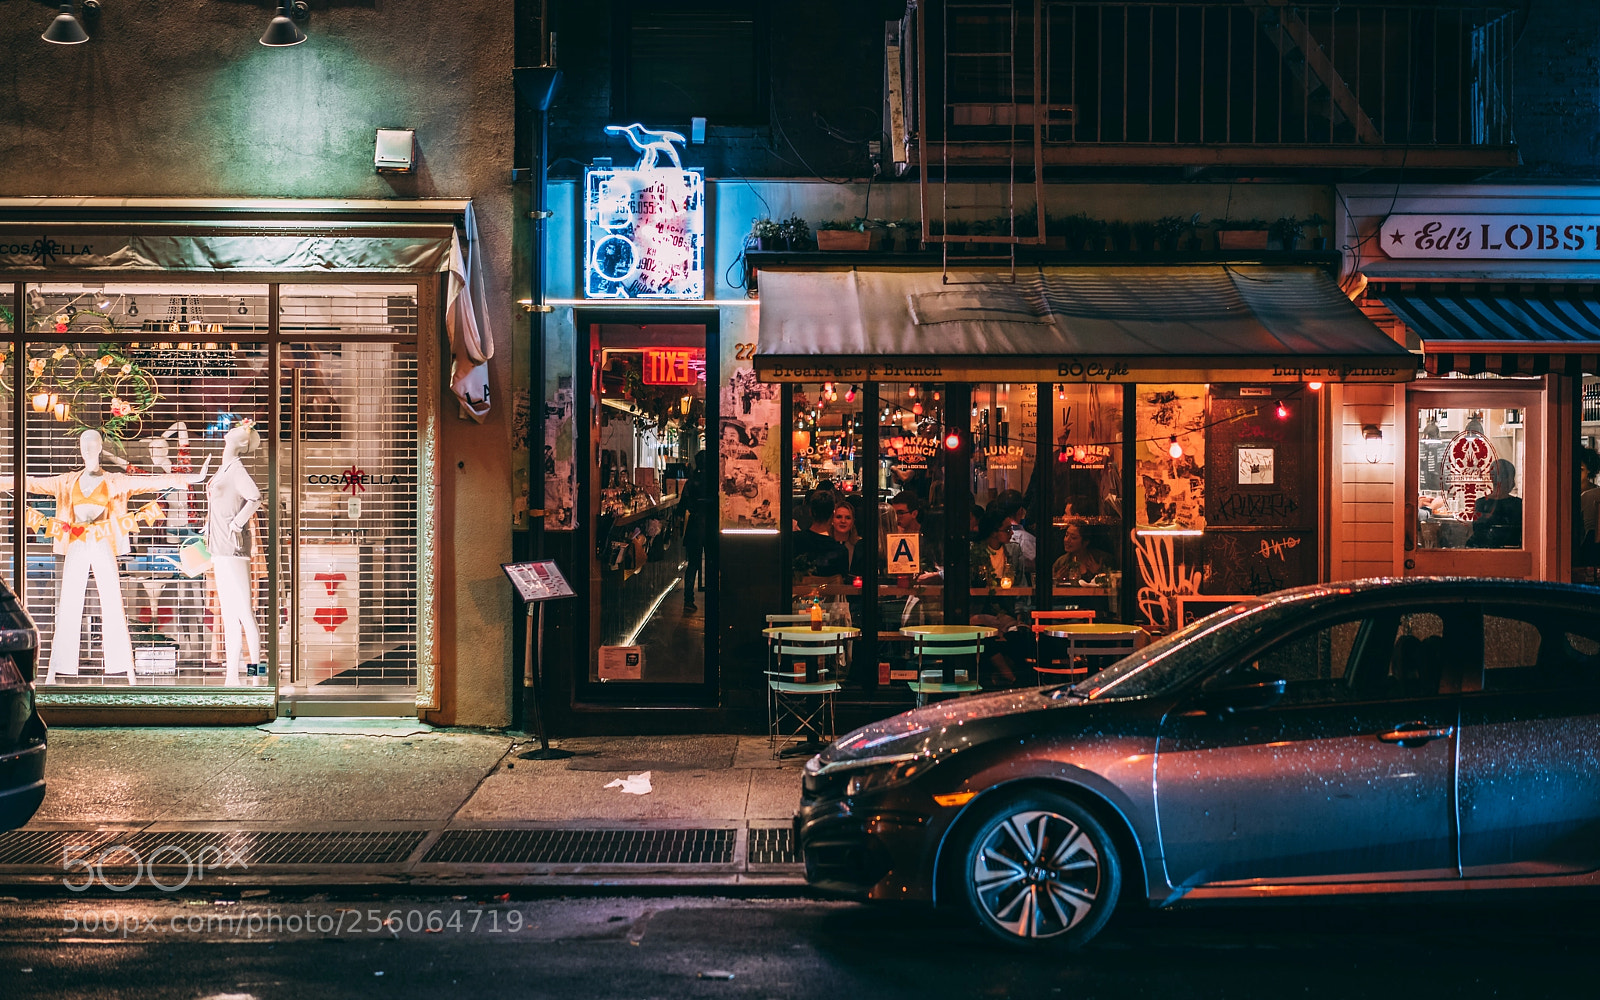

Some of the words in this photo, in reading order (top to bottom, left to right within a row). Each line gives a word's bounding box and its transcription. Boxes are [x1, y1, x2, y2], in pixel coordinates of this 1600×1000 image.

[1414, 222, 1472, 250] Ed's
[773, 364, 862, 377] Breakfast
[868, 363, 877, 376] &
[882, 363, 943, 376] Brunch
[1272, 364, 1320, 376] Lunch
[1327, 362, 1336, 376] &
[1342, 364, 1398, 376] Dinner
[983, 445, 1024, 457] LUNCH
[308, 475, 400, 484] COSABELLA
[892, 538, 914, 562] A
